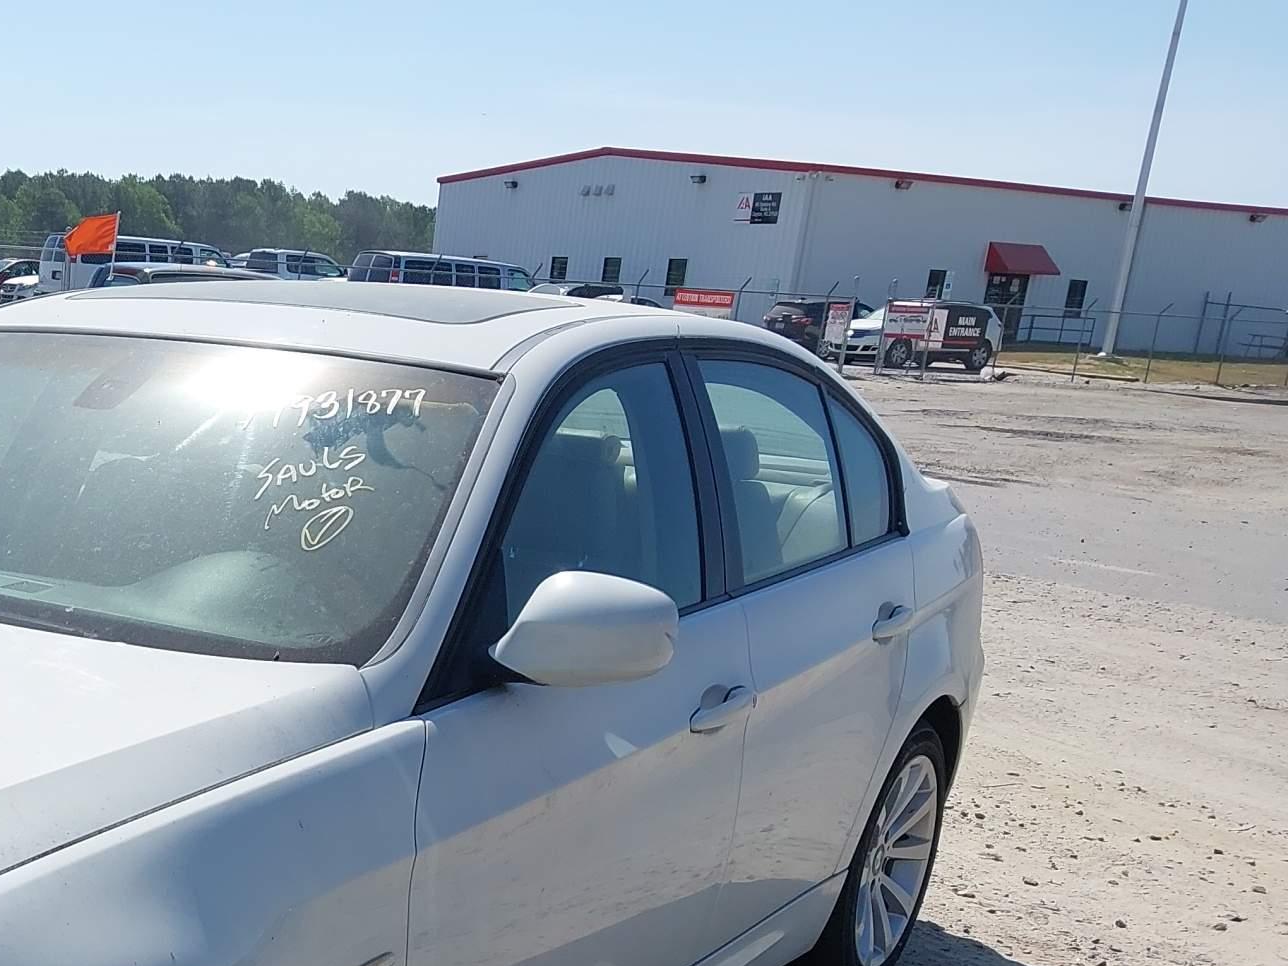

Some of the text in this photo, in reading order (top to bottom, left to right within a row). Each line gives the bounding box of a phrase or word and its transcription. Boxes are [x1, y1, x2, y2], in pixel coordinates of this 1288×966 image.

[958, 316, 976, 326] MAIN
[948, 327, 982, 337] ENTRANCE
[242, 388, 426, 431] 931877
